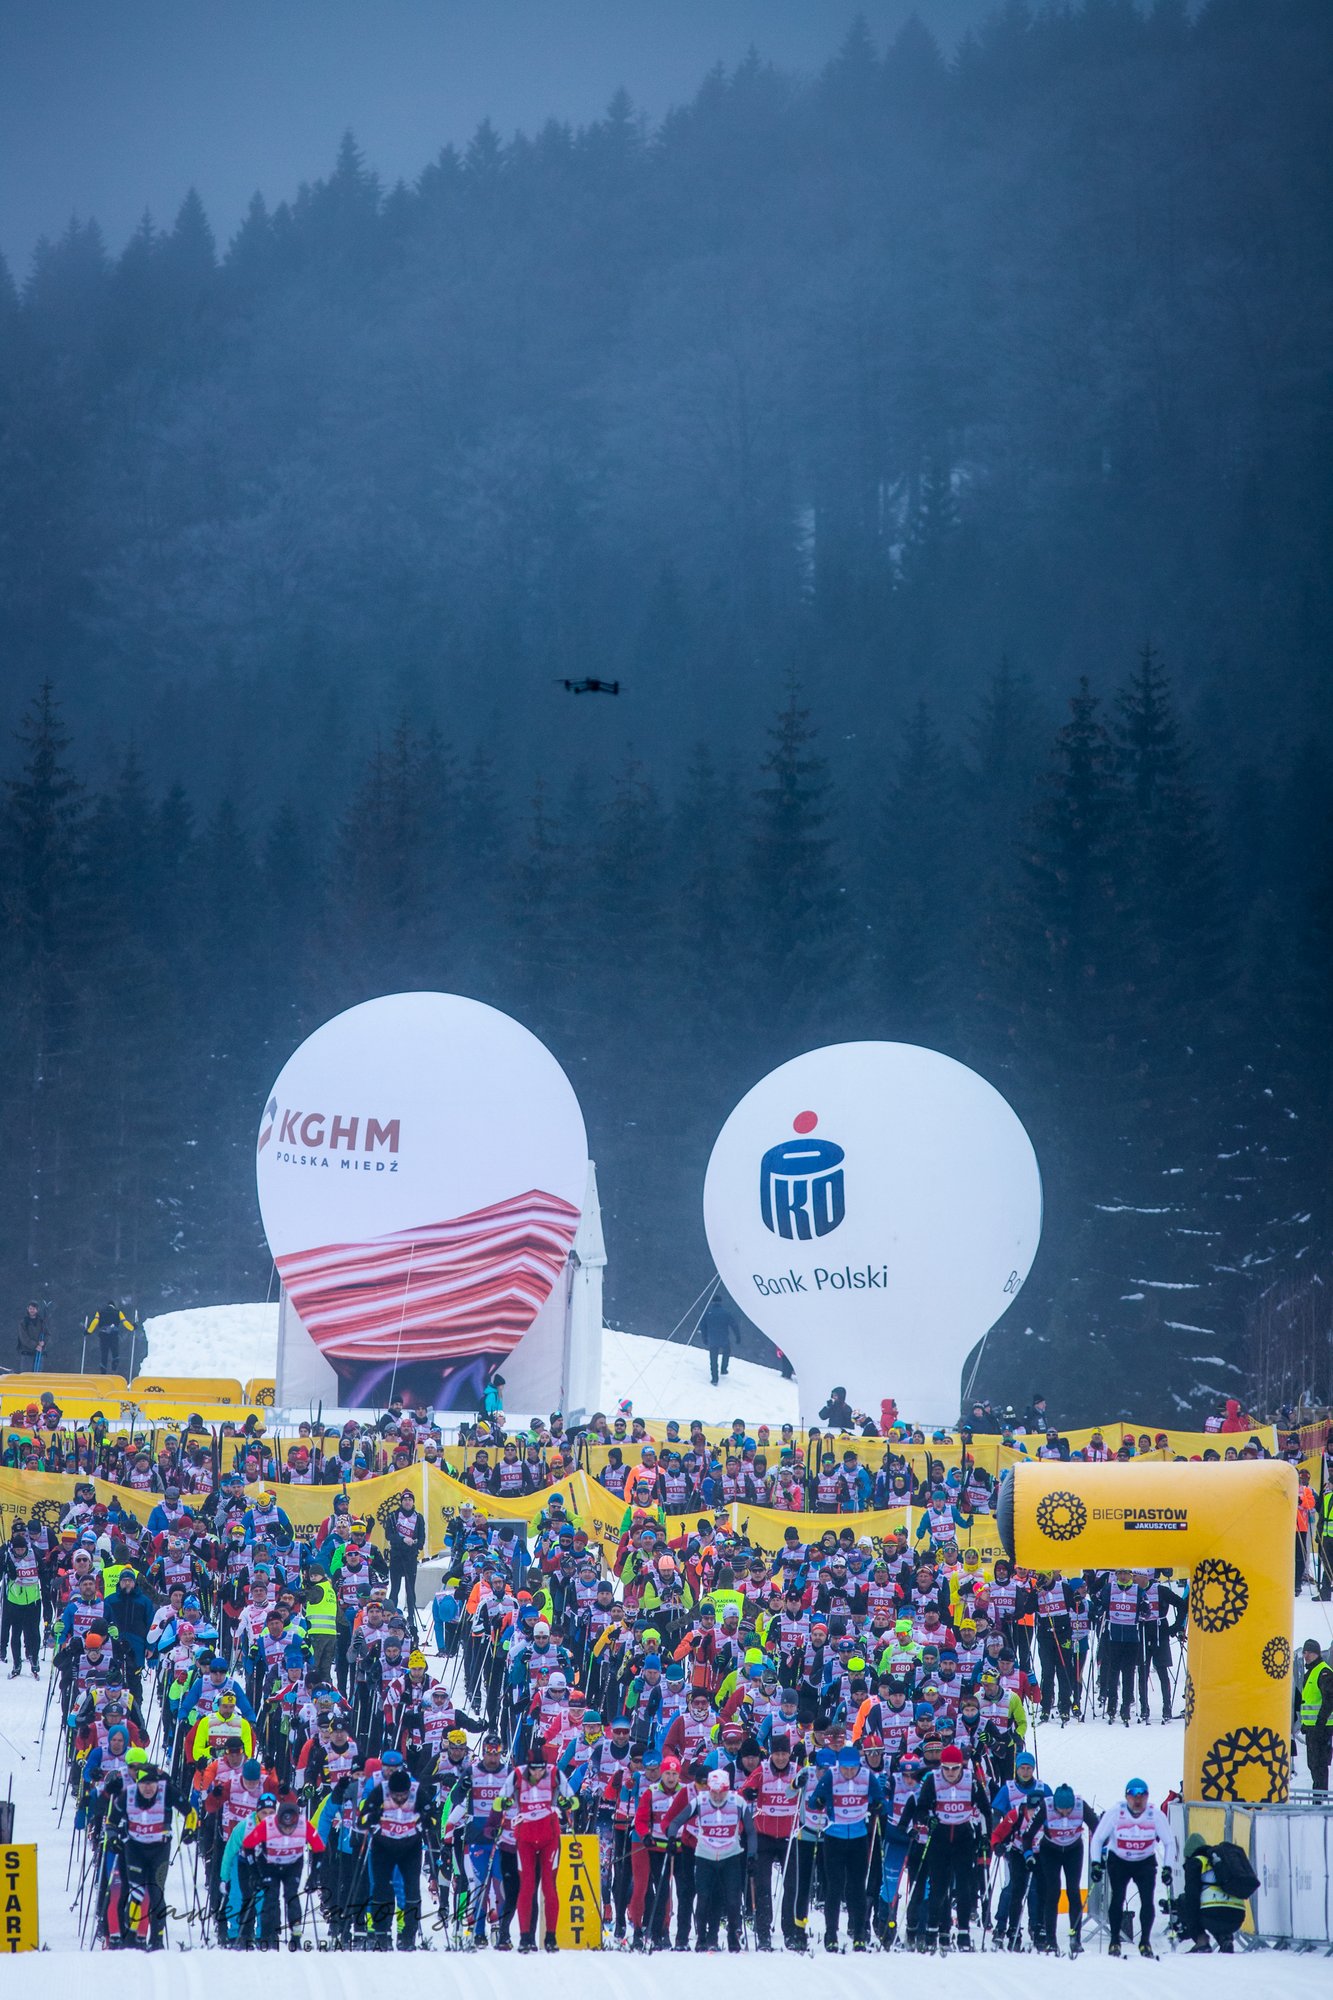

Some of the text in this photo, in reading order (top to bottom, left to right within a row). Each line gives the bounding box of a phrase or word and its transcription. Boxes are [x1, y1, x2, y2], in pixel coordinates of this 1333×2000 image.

[278, 1108, 401, 1154] KGHM
[276, 1151, 399, 1173] POLSKA MIEDŹ
[752, 1264, 888, 1296] Bank Polski
[1092, 1507, 1188, 1520] BIEGPIASTÓW
[1134, 1522, 1178, 1530] JAKUSZYCE
[19, 1567, 36, 1577] 1091
[171, 1575, 187, 1583] 920
[993, 1597, 1013, 1605] 1098
[1115, 1603, 1132, 1611] 909
[895, 1665, 911, 1673] 680
[430, 1718, 448, 1728] 753
[770, 1795, 789, 1804] 782
[841, 1796, 862, 1806] 807
[943, 1803, 965, 1812] 600
[568, 1841, 586, 1945] START
[4, 1851, 22, 1953] START
